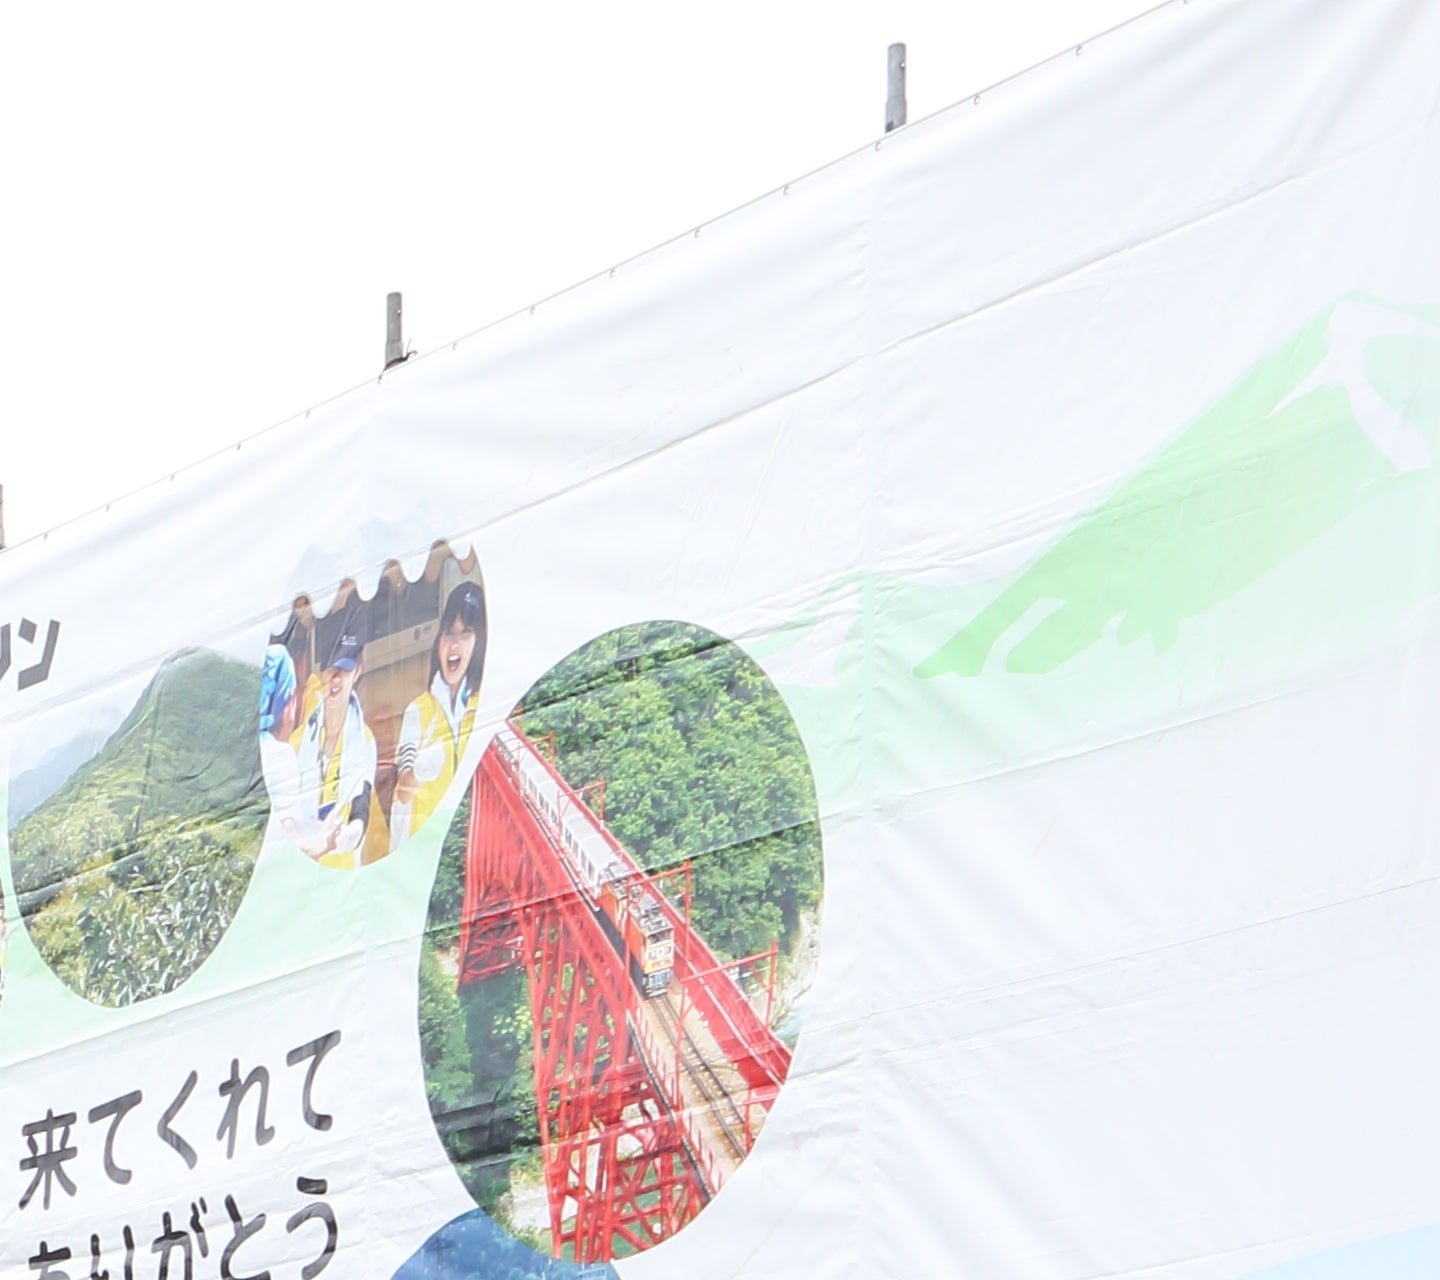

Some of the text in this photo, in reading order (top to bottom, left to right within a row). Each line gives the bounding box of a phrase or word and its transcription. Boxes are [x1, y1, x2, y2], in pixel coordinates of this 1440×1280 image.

[18, 1028, 342, 1210] 来てくれて
